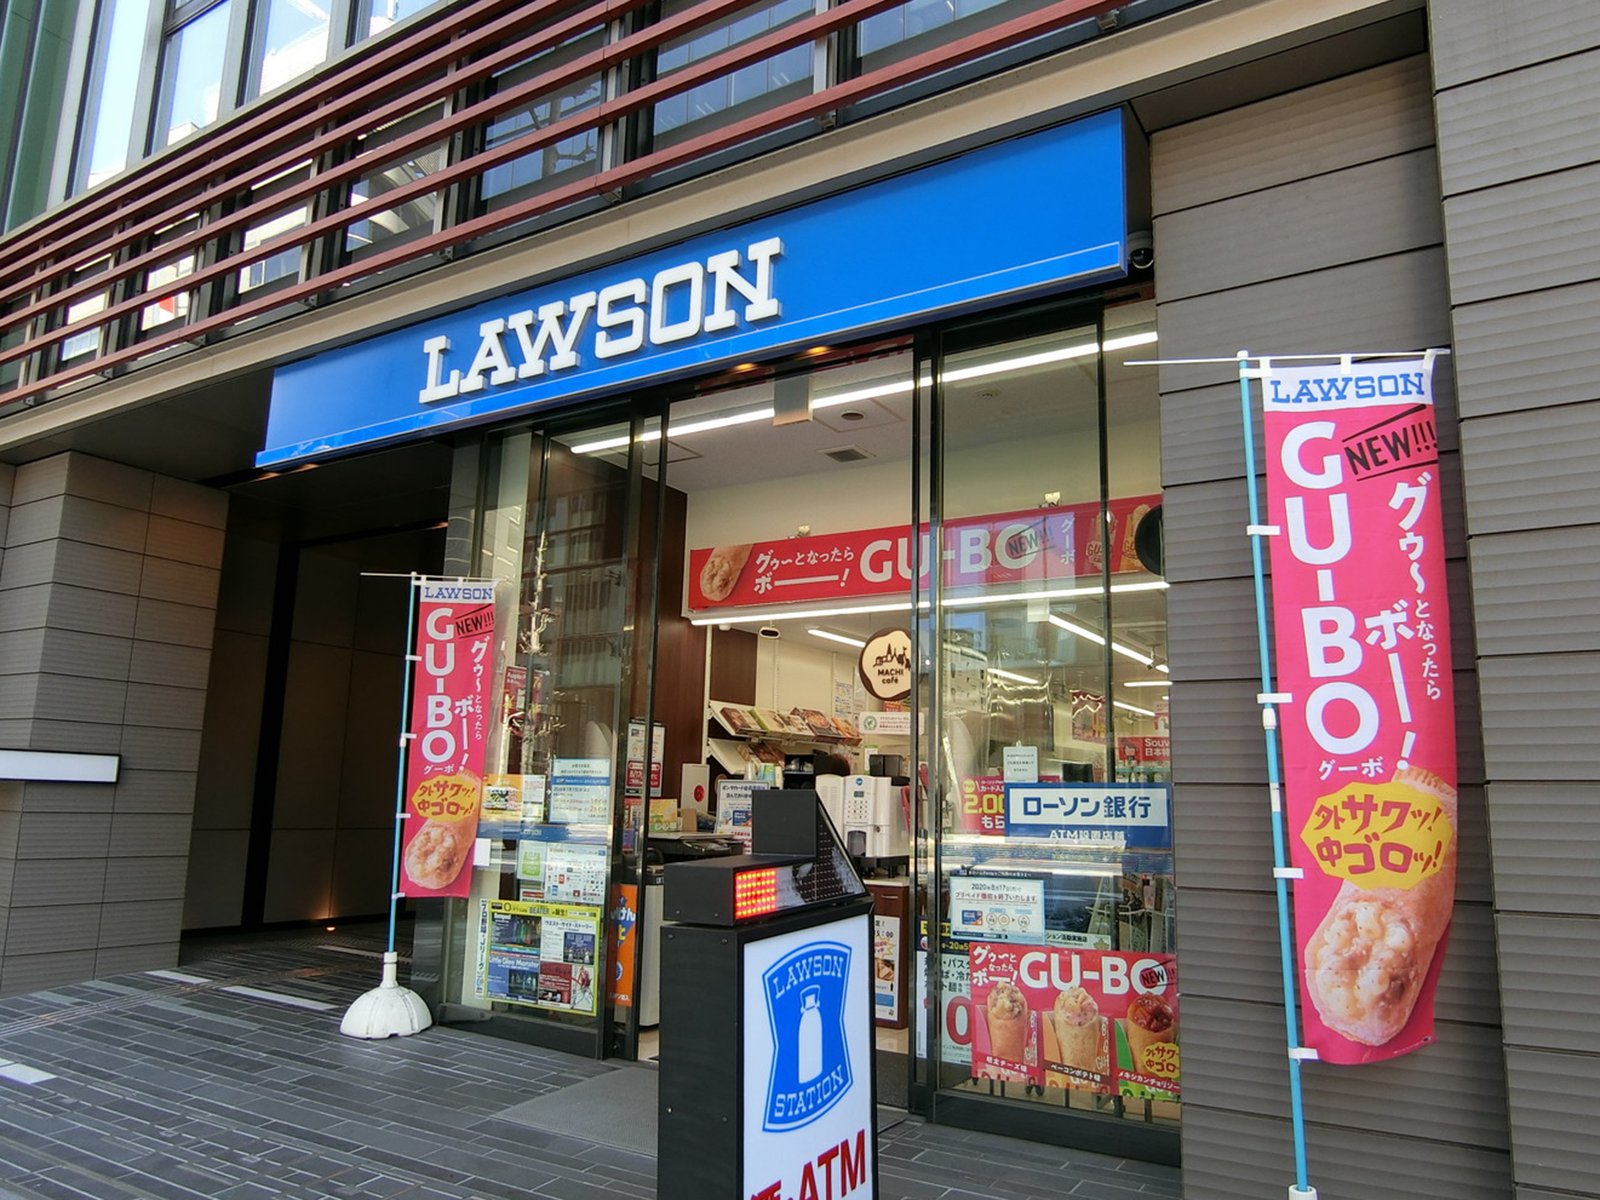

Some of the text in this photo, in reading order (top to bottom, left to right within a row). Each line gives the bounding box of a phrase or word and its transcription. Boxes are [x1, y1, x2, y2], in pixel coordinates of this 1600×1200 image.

[419, 237, 783, 404] LAWSON
[1270, 372, 1425, 403] LAWSON
[1343, 420, 1438, 475] NEW!!!
[860, 523, 1038, 583] GU-BO
[424, 586, 493, 600] LAWSON
[1281, 421, 1379, 755] GU-BO
[455, 612, 494, 636] NEW!!!
[421, 607, 456, 763] GU-BO
[877, 667, 904, 677] MACHI
[423, 763, 455, 775] グーボ
[1318, 756, 1384, 781] グーボ
[1022, 795, 1152, 818] ローソン銀行
[772, 955, 844, 1000] LAWSON
[1019, 951, 1168, 996] GU-BO
[1146, 1046, 1178, 1058] 外サク
[1146, 1060, 1178, 1073] 中ゴロ
[1051, 1063, 1102, 1082] ベーコンポテト味
[774, 1064, 844, 1117] STATION
[799, 1129, 866, 1200] ATM
